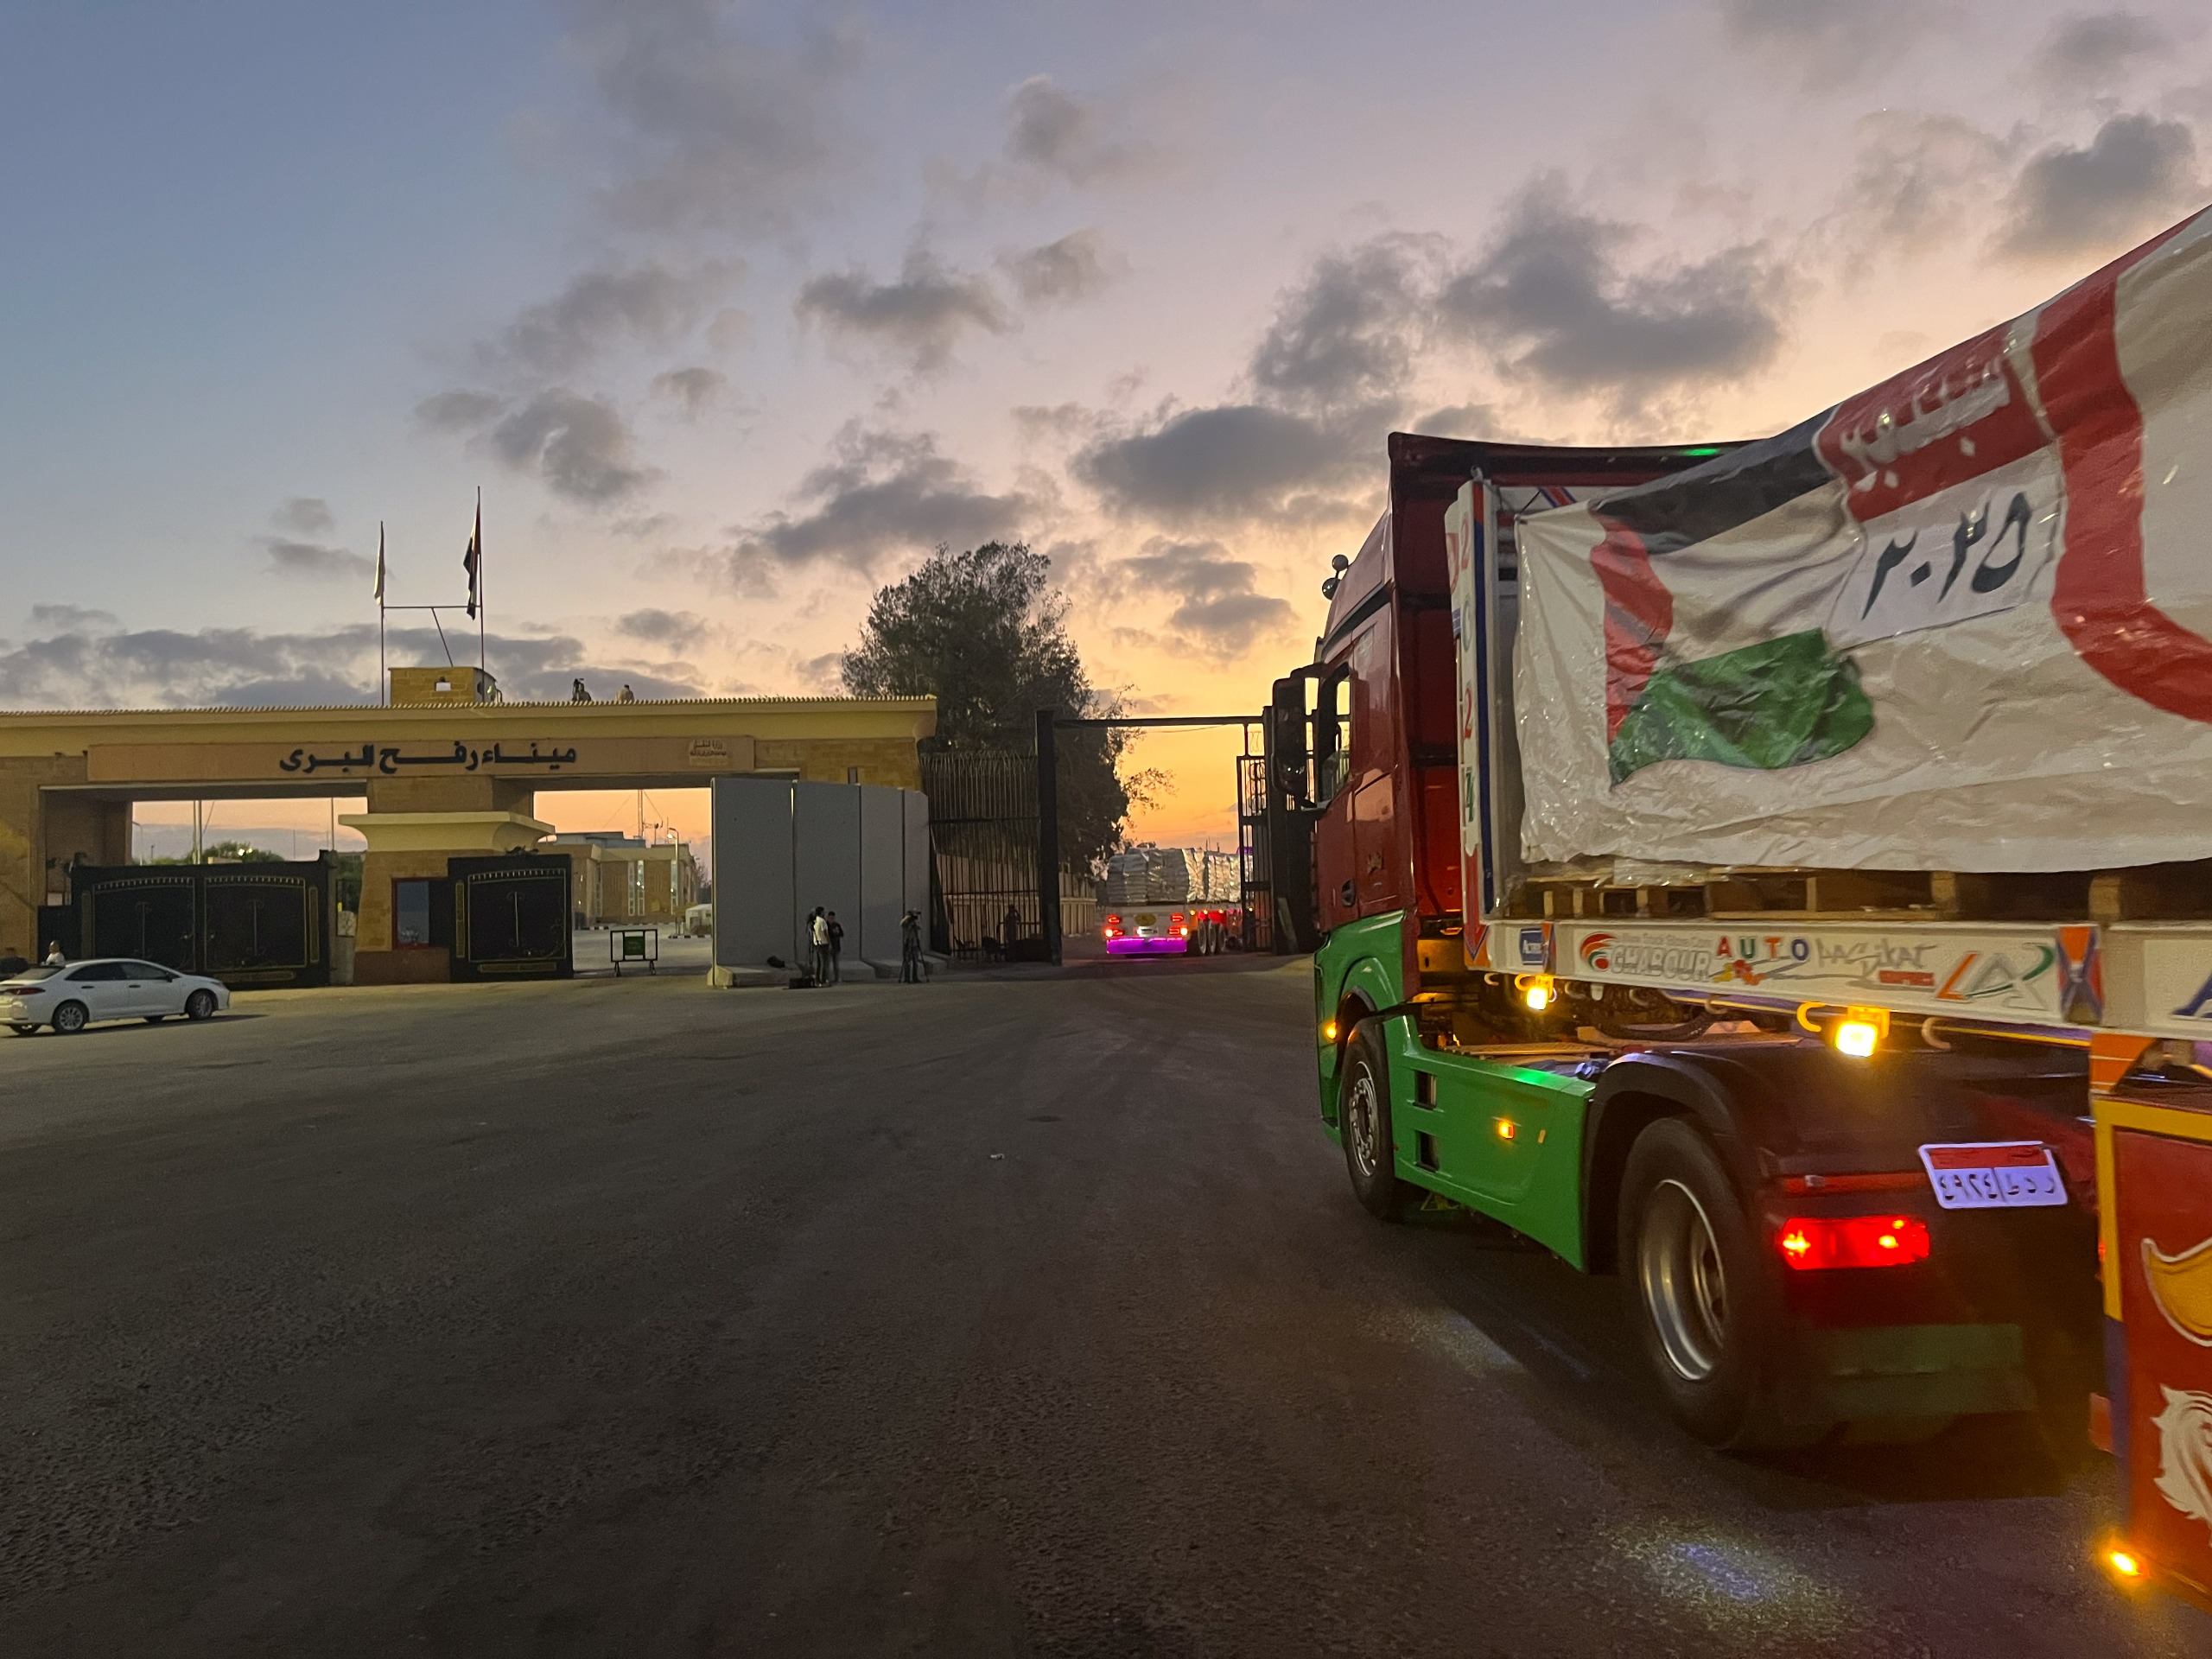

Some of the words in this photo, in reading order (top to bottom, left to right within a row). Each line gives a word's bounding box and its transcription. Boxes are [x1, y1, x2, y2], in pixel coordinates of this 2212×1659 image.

[378, 741, 480, 774] رفح
[481, 742, 577, 771] ميناء
[1716, 936, 1810, 962] AUTO
